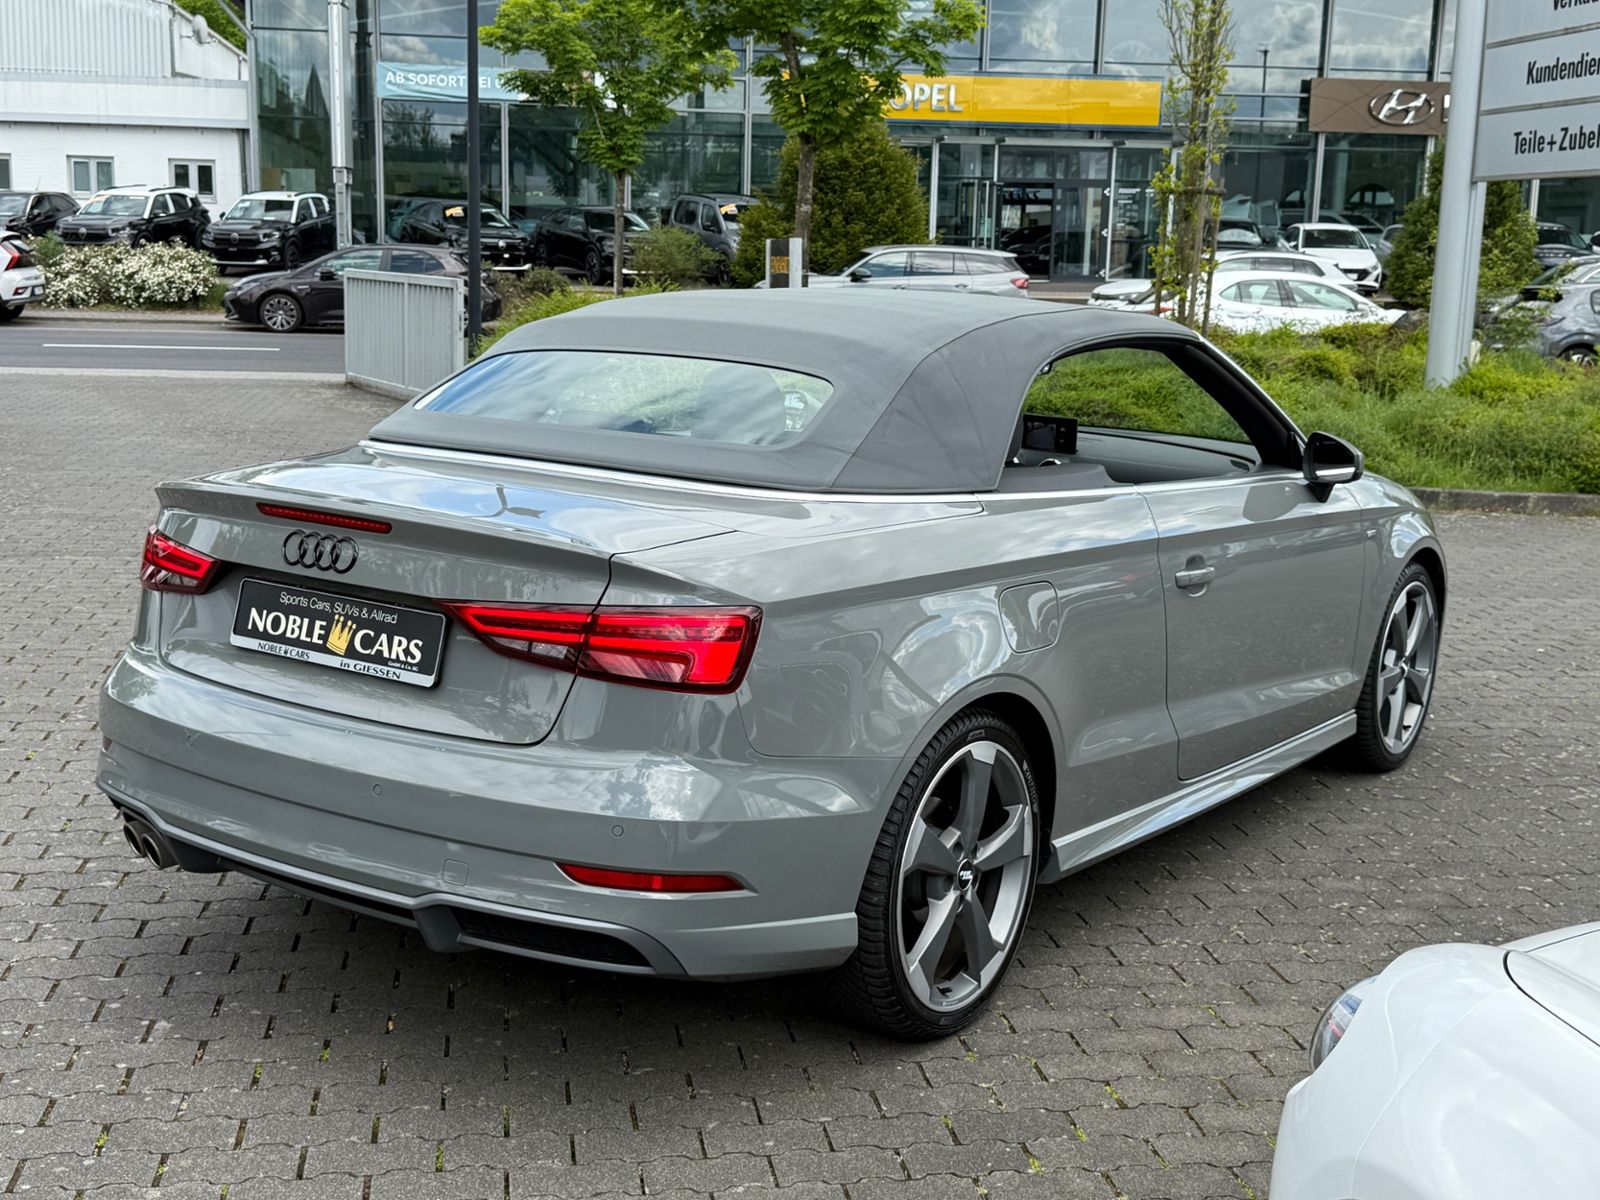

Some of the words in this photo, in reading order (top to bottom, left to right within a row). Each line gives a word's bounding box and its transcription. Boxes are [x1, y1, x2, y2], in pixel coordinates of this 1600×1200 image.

[385, 71, 405, 84] AB
[408, 73, 466, 88] SOFORT
[889, 82, 963, 112] OPEL
[279, 591, 309, 607] Sports
[309, 597, 332, 613] Cars,
[333, 601, 360, 617] SUVs
[360, 607, 369, 619] &
[370, 609, 398, 624] Allrad
[247, 607, 327, 645] NOBLE
[353, 628, 423, 664] CARS
[257, 641, 284, 655] NOBLE
[289, 648, 311, 660] CARS
[340, 659, 351, 669] in
[353, 662, 401, 680] GIESSEN
